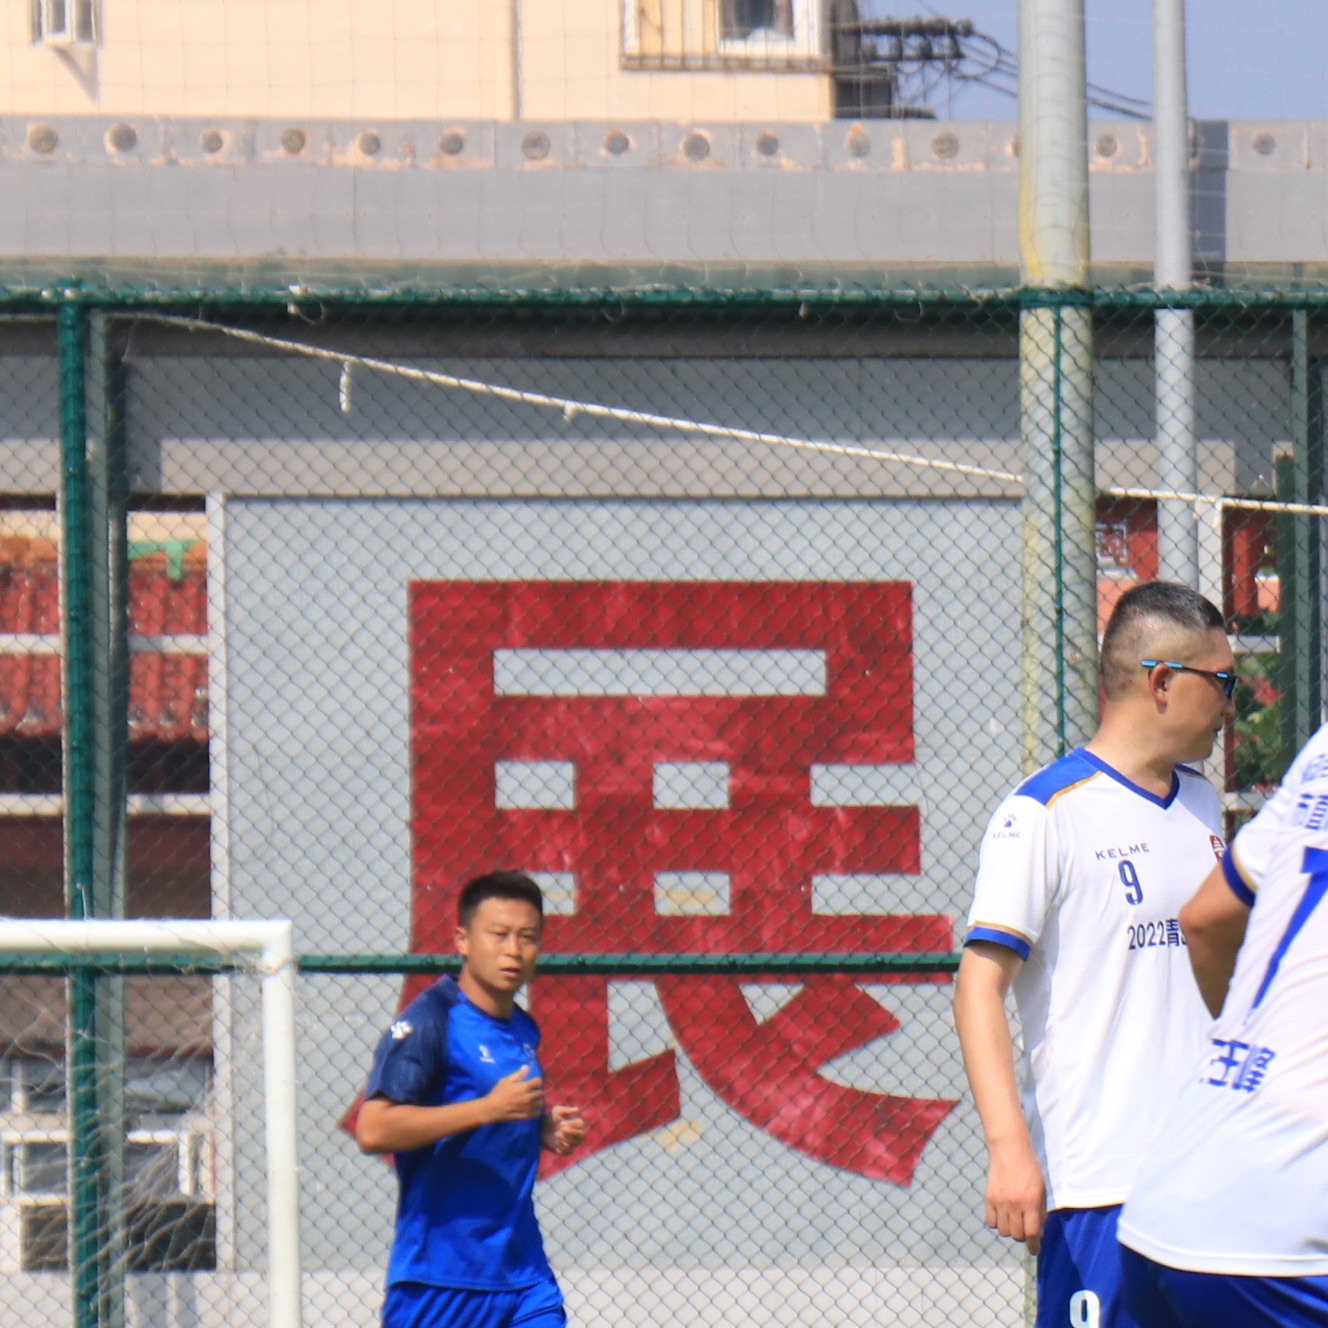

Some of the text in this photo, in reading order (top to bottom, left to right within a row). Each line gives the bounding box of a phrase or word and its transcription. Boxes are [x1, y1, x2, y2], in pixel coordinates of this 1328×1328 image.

[1095, 843, 1151, 860] KELME
[1118, 859, 1144, 906] 9
[1127, 917, 1188, 951] 2022青
